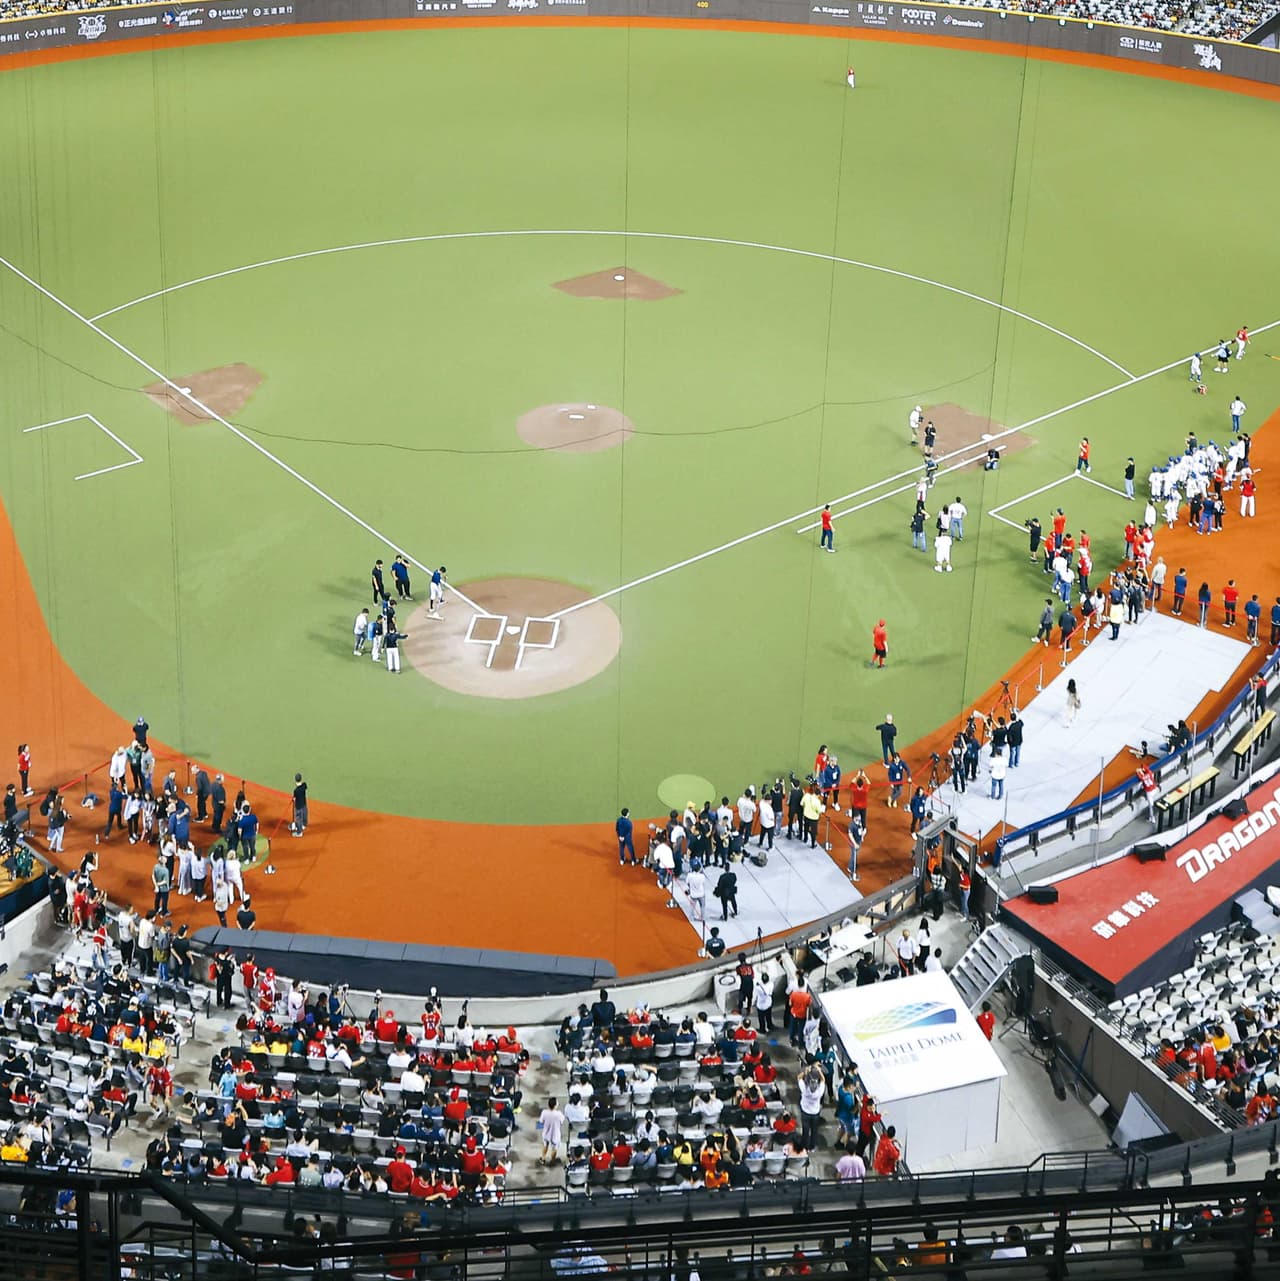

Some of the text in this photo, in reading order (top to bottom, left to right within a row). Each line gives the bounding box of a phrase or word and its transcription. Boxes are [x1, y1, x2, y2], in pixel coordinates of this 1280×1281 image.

[822, 6, 849, 16] Kappa
[901, 8, 937, 21] FOOTER
[865, 1032, 966, 1060] TAIPEI DOME
